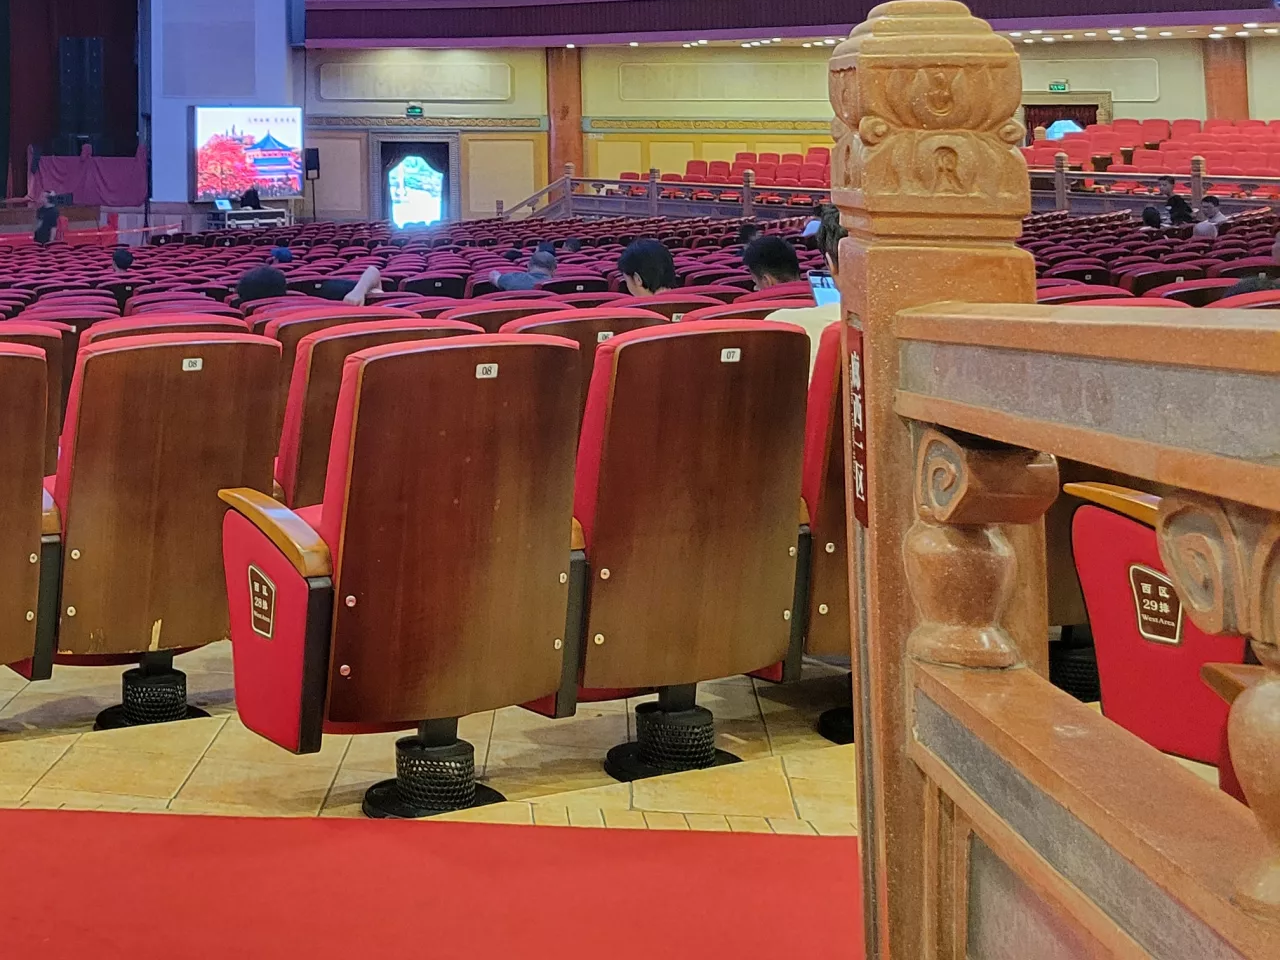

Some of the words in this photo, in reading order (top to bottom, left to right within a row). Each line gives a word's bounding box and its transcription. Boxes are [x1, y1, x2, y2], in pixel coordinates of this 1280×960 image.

[726, 351, 736, 360] 07
[188, 360, 197, 369] 08
[482, 366, 492, 375] 08
[1141, 582, 1170, 599] 西区
[1143, 598, 1171, 614] 29排
[1141, 613, 1158, 623] West
[1158, 616, 1176, 627] Area
